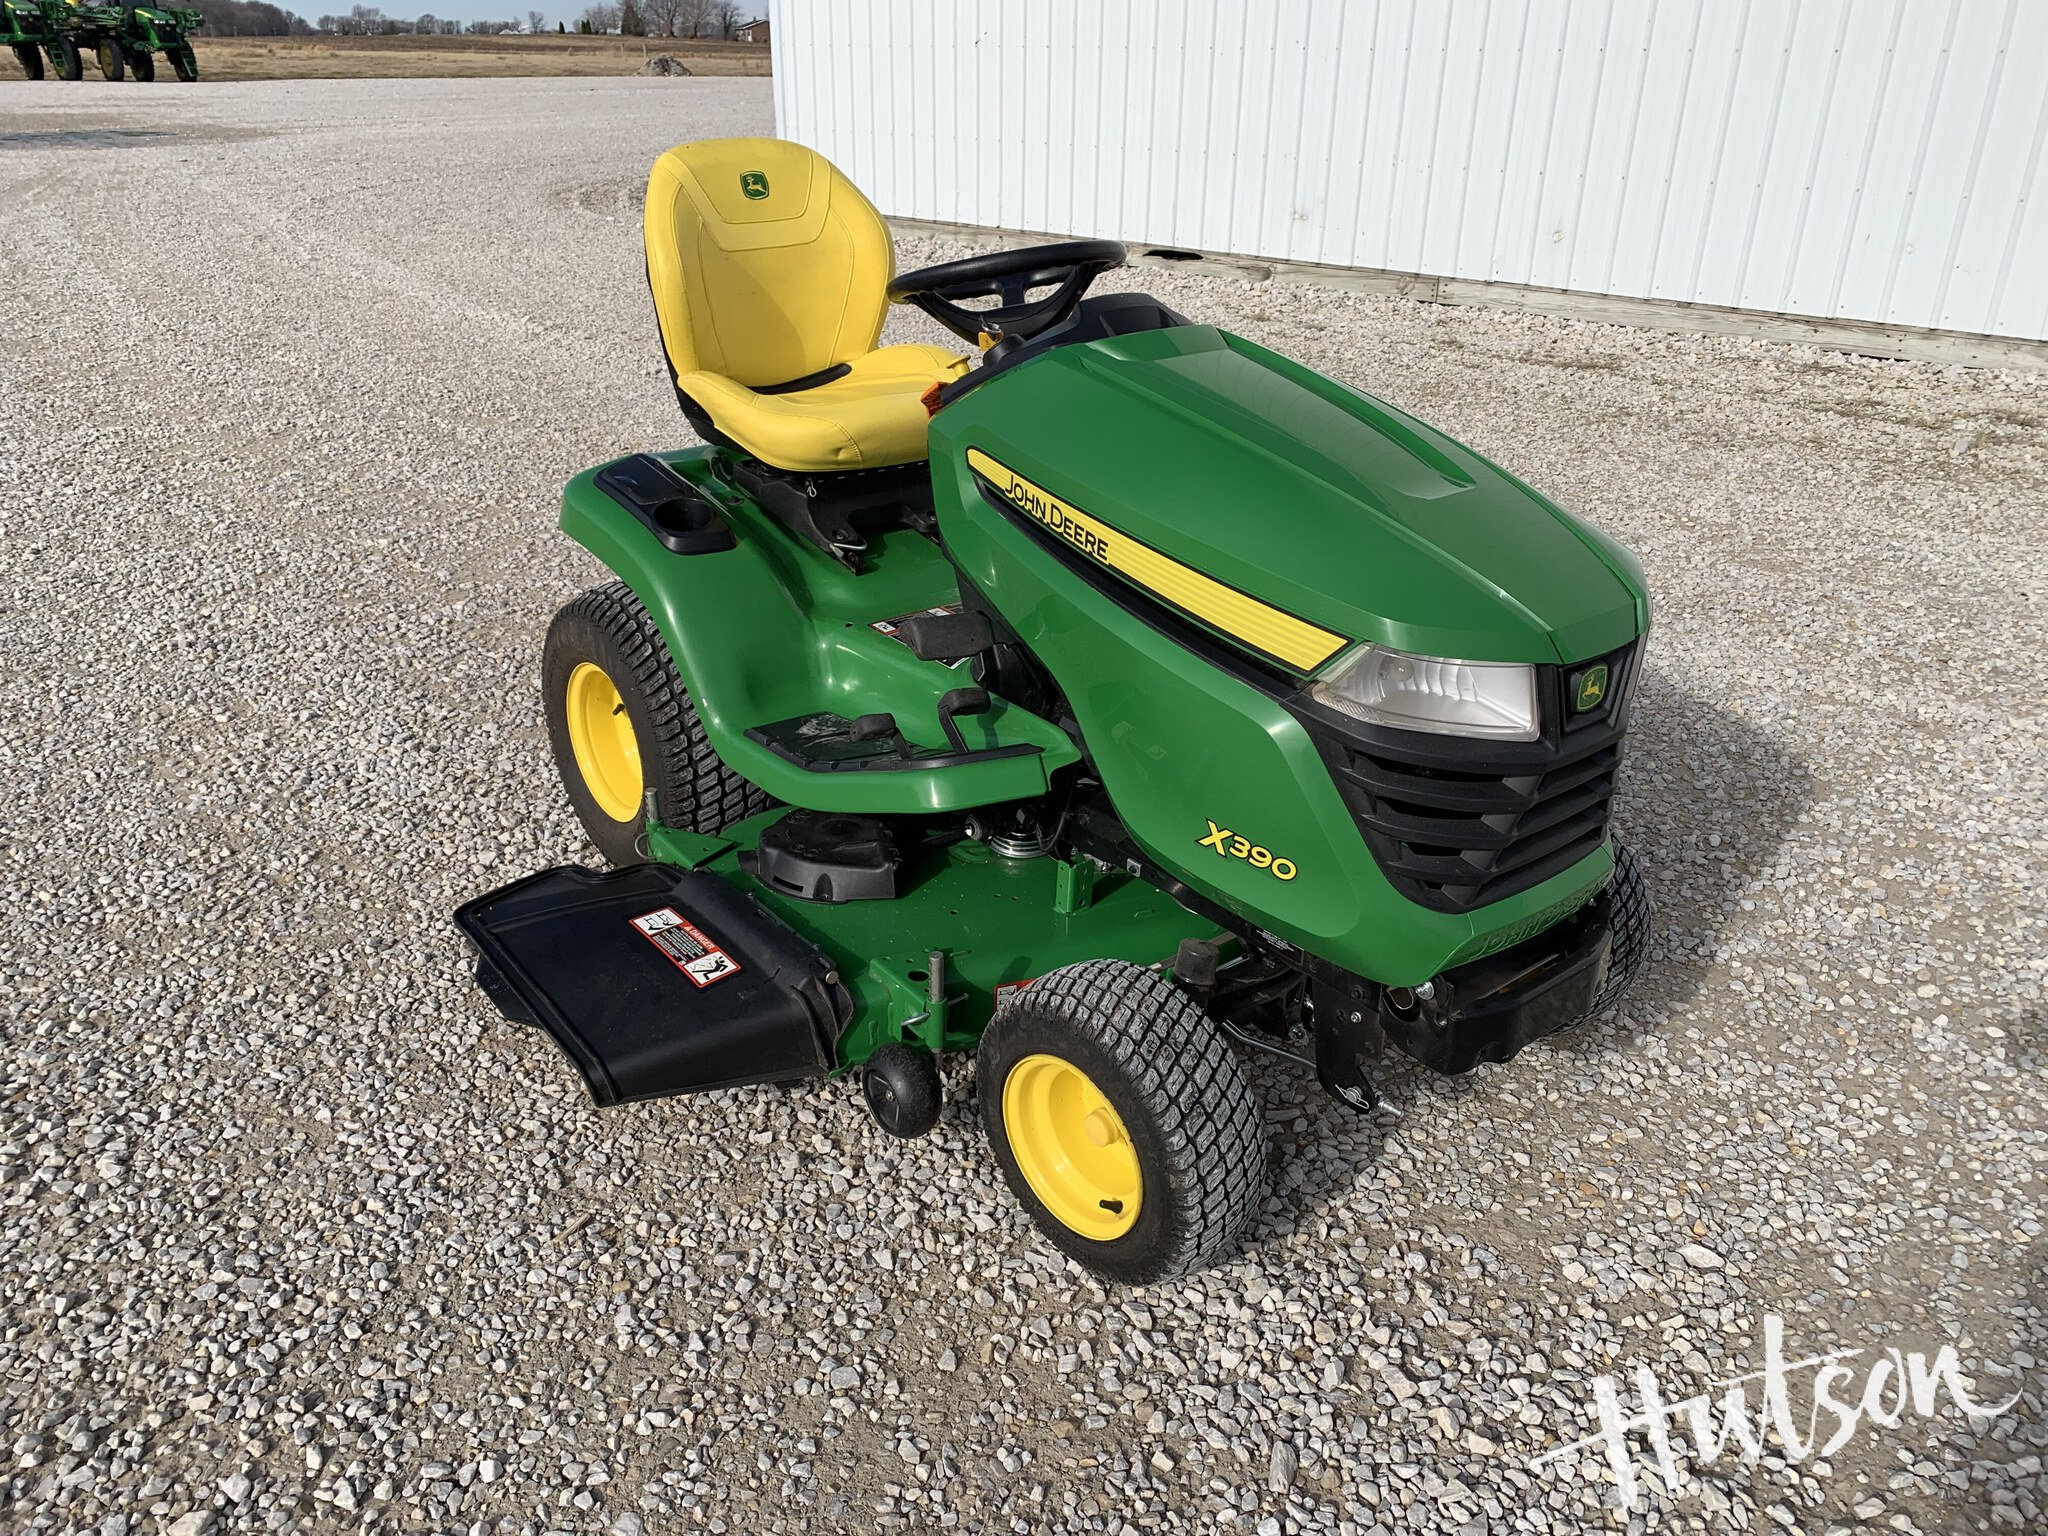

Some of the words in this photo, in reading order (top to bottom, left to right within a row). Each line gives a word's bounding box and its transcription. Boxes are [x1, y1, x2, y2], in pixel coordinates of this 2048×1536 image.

[1005, 475, 1046, 521] JOHN
[1050, 504, 1109, 562] DEERE
[1195, 817, 1298, 881] X390
[690, 928, 715, 950] DANGER
